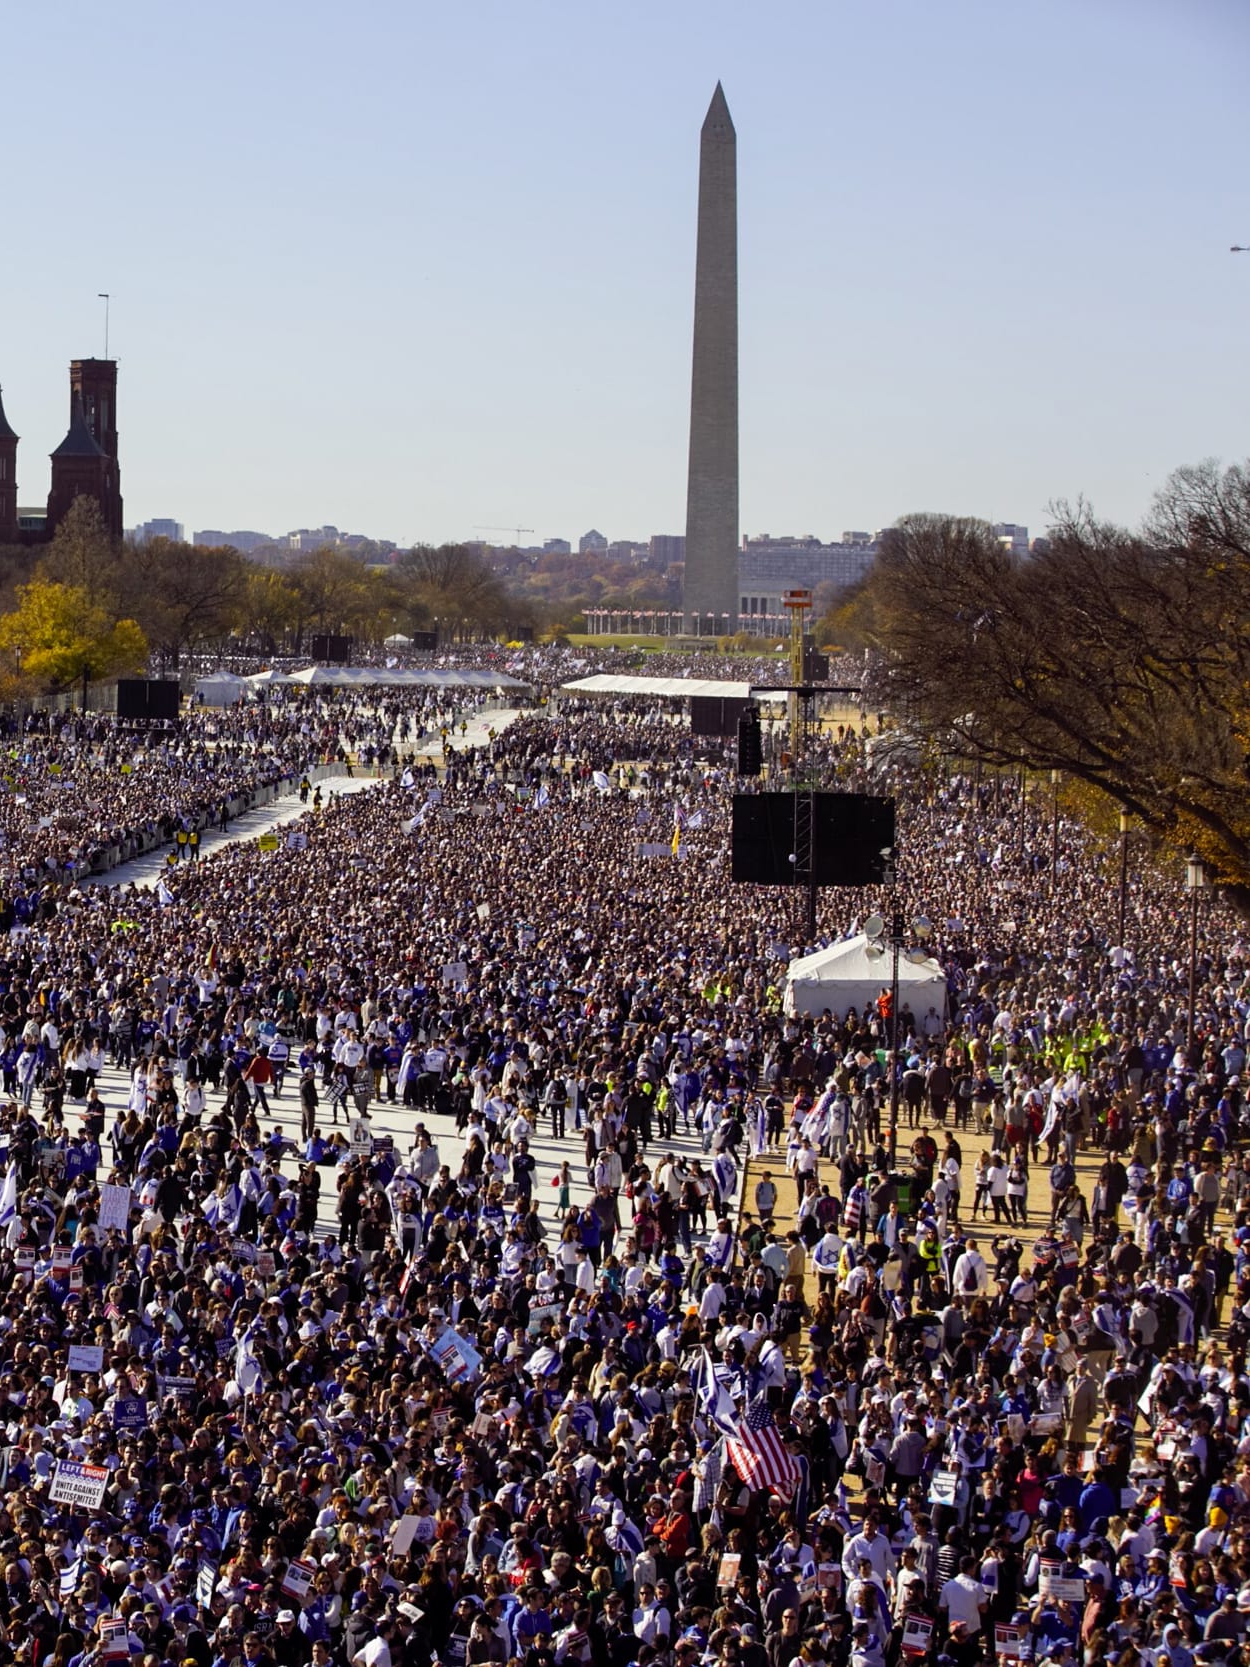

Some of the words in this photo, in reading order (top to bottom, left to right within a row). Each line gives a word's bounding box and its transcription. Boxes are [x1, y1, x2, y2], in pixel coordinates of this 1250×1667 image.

[61, 1463, 81, 1473] LEFT
[86, 1468, 107, 1479] RIGHT
[55, 1480, 74, 1491] UNITE
[73, 1484, 101, 1497] AGAINST
[53, 1490, 97, 1506] ANTISEMITES
